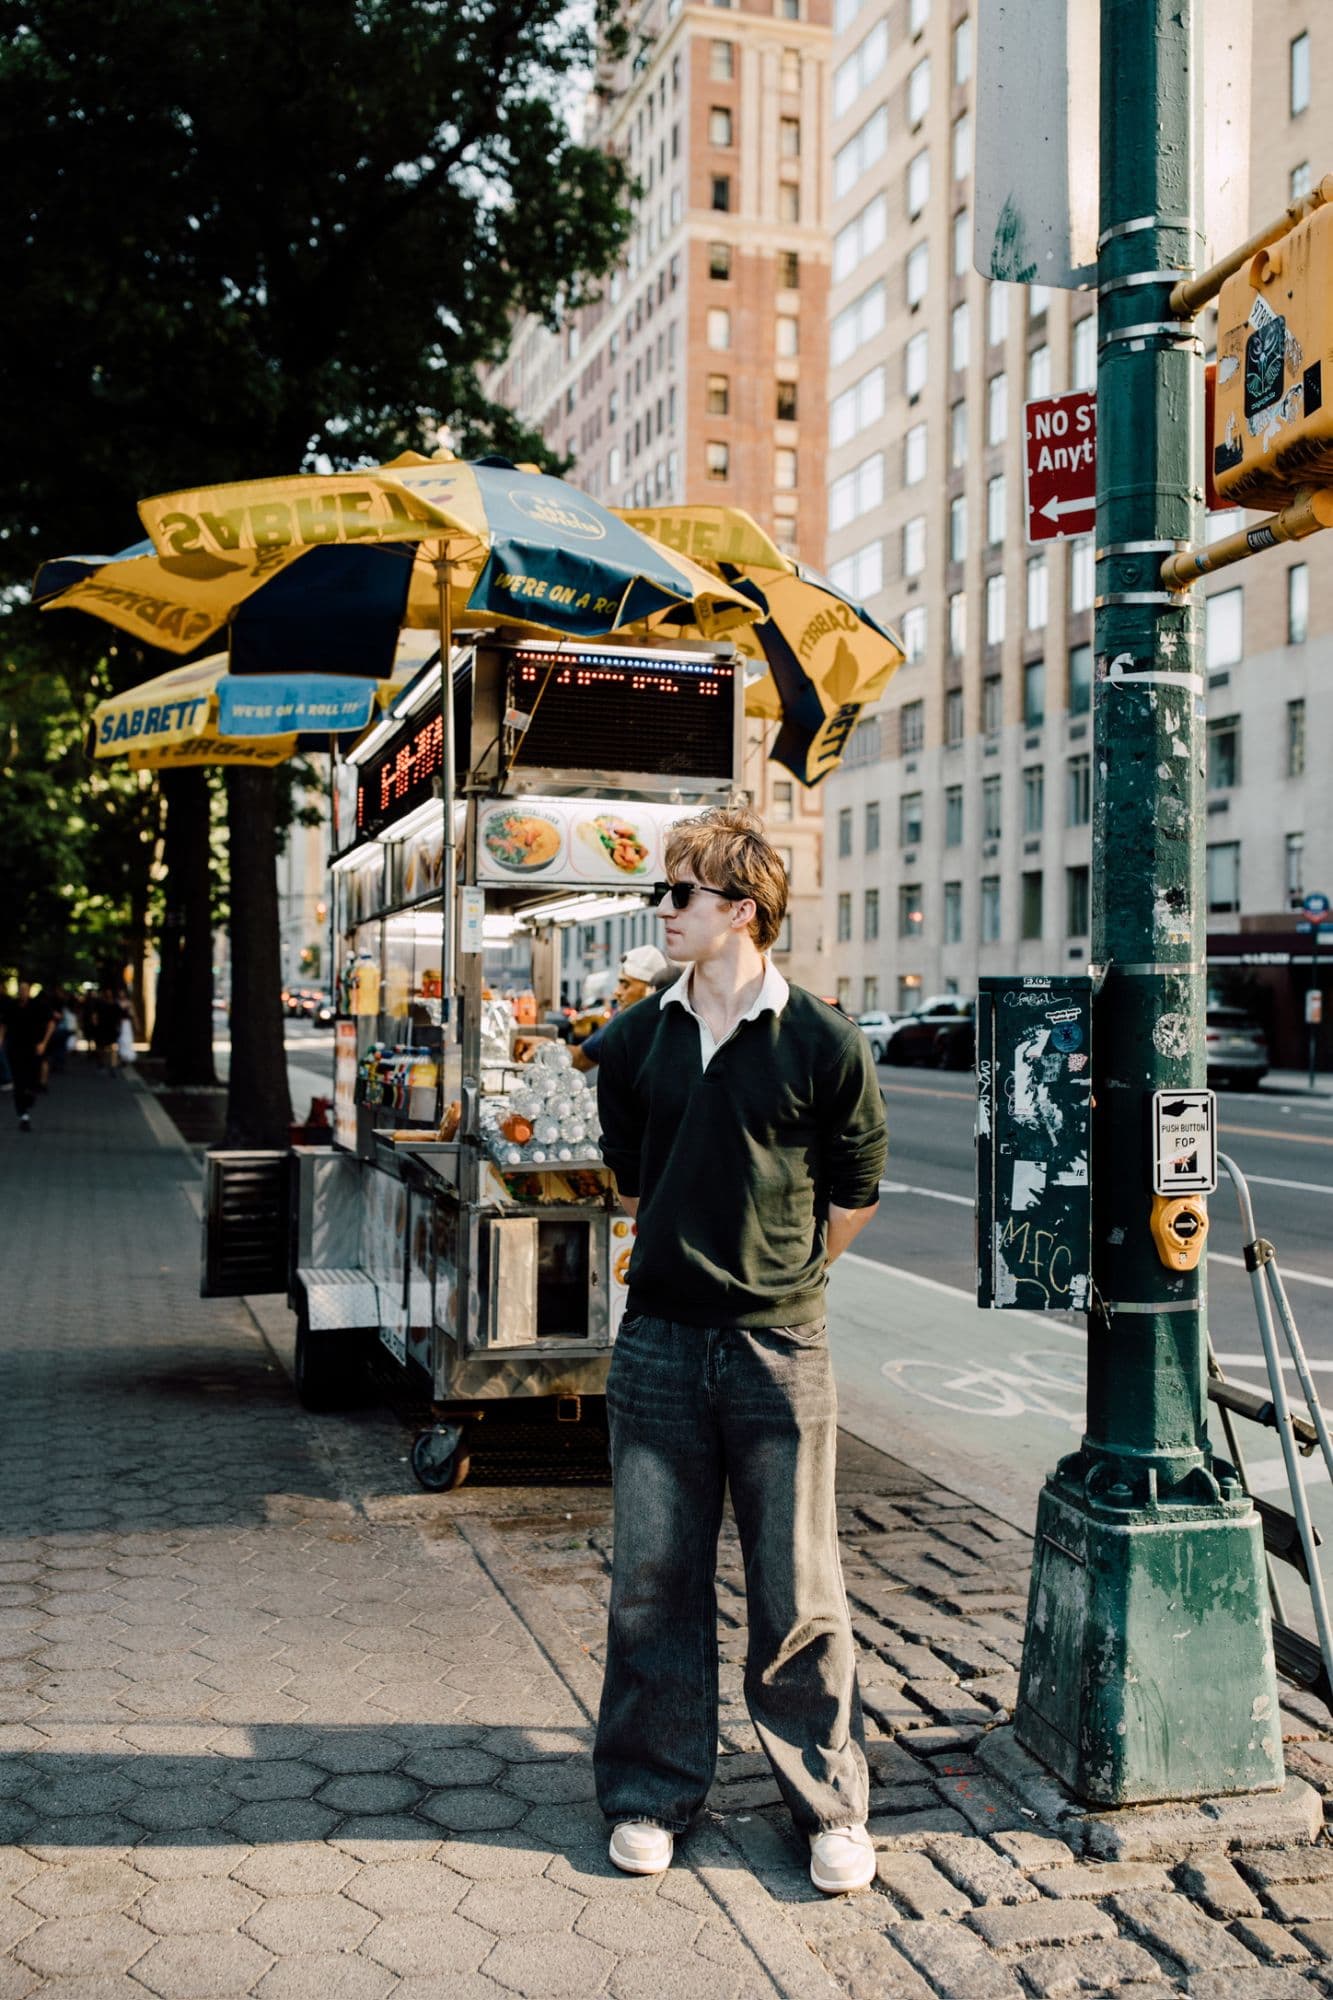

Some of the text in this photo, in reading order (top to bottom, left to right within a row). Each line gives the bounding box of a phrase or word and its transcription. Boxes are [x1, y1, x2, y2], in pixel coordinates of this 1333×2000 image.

[1035, 409, 1069, 440] NO
[549, 585, 577, 605] ON
[575, 593, 591, 608] A
[100, 698, 206, 745] SABRETT
[1161, 1123, 1205, 1133] PUSH BUTTON
